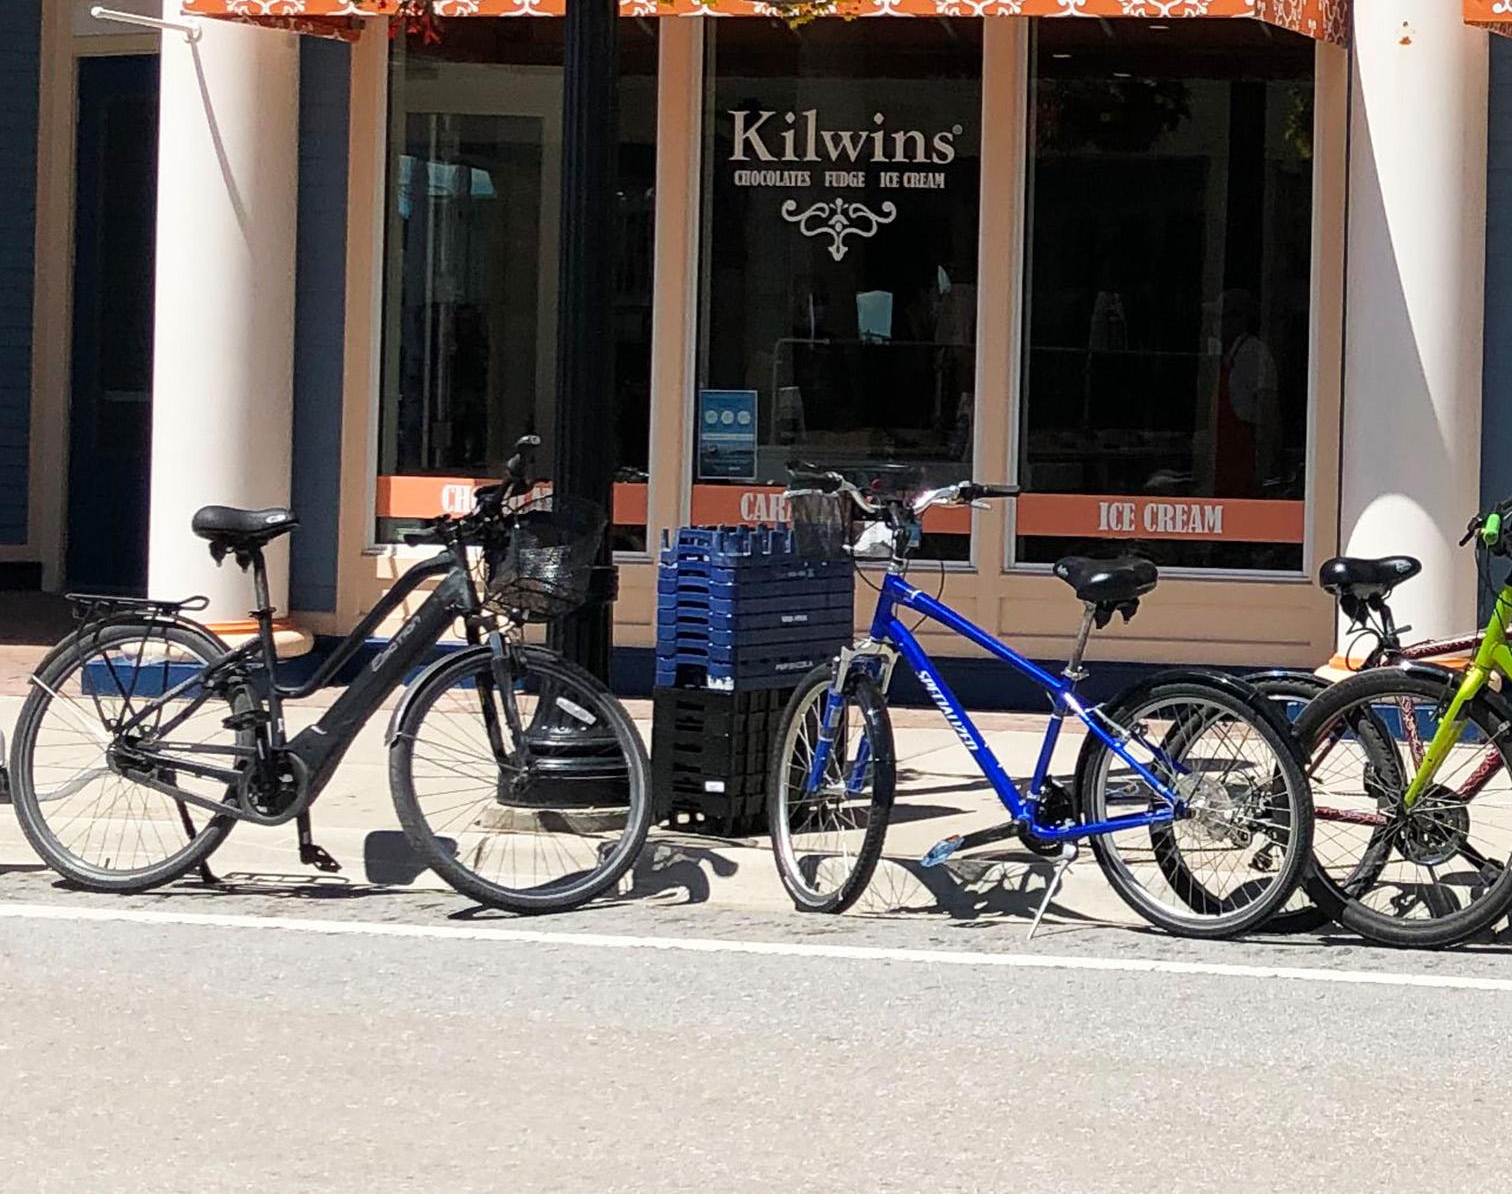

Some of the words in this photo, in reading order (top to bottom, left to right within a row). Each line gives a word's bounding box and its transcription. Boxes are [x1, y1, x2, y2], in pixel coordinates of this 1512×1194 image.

[734, 170, 811, 187] CHOCOLATES
[824, 171, 866, 188] FUDGE
[879, 172, 900, 188] ICE
[903, 172, 945, 189] CREAM
[1098, 501, 1136, 532] ICE
[1143, 502, 1224, 535] CREAM
